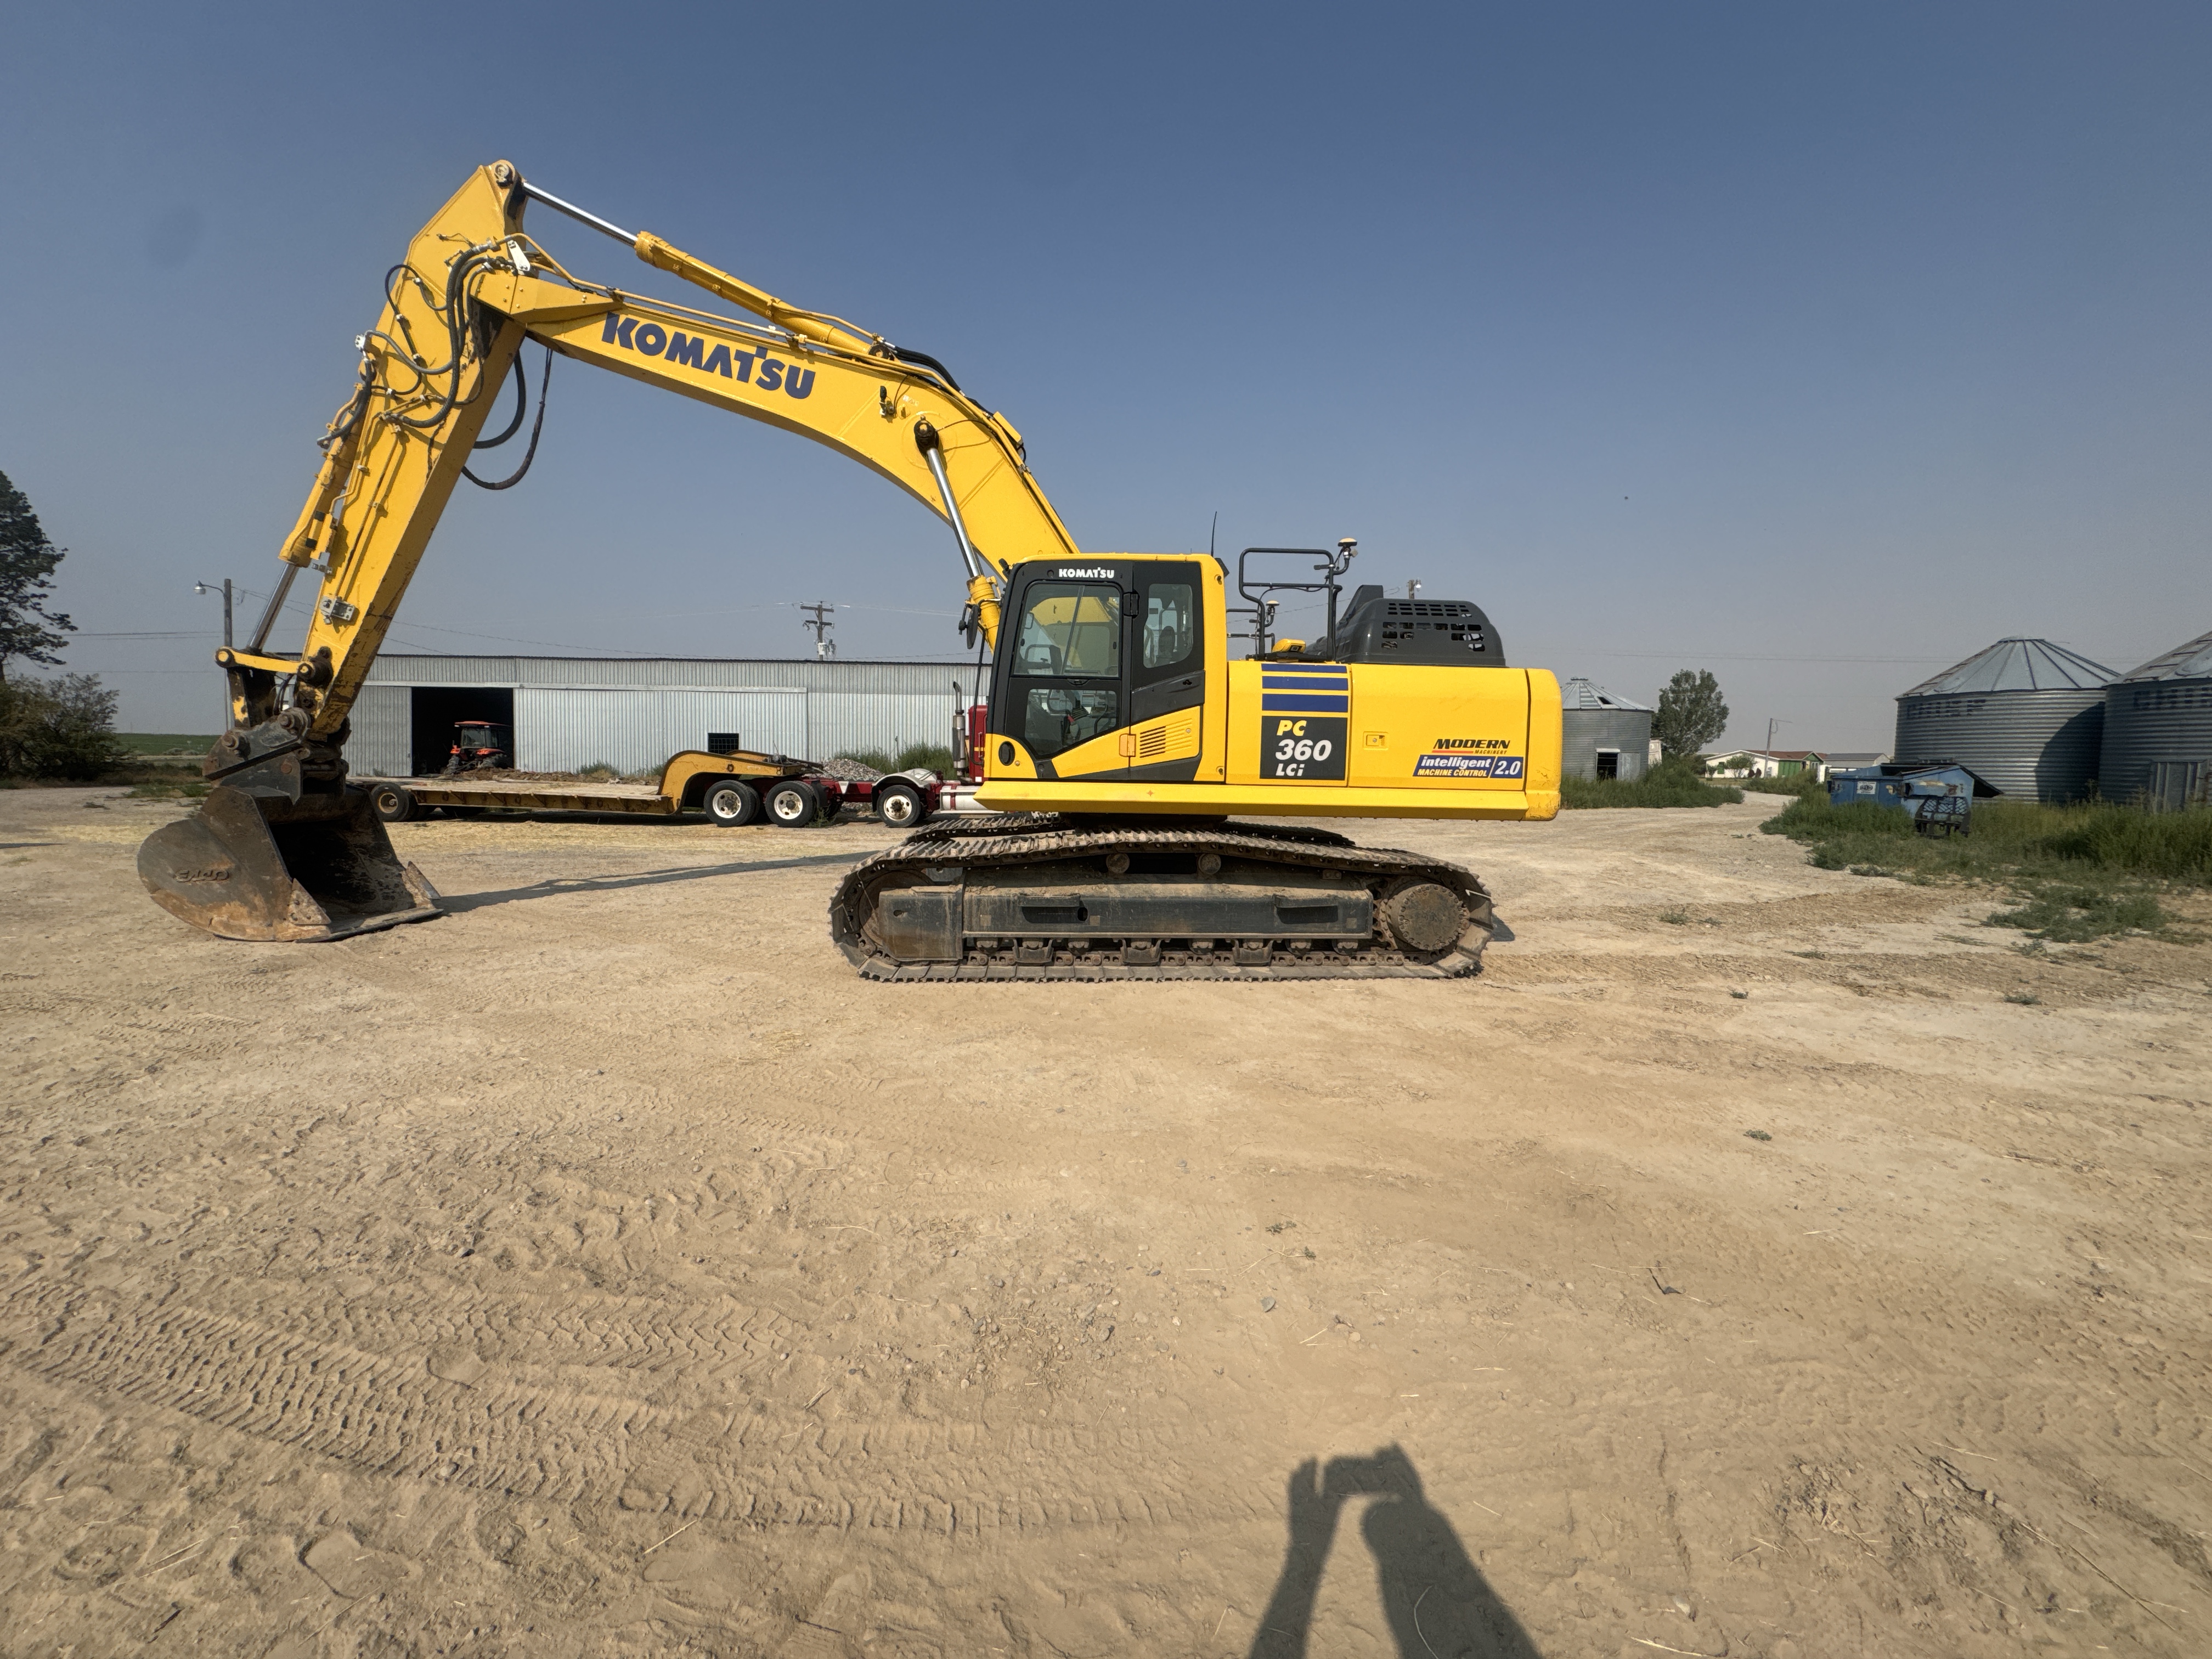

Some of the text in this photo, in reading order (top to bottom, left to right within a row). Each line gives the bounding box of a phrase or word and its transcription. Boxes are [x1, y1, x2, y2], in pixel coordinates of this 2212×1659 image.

[602, 311, 816, 399] KOMATSU
[1059, 567, 1114, 579] KOMATSU
[1276, 719, 1307, 737] PC
[1275, 738, 1332, 761] 360
[1433, 738, 1510, 749] MODERN
[1276, 763, 1305, 777] LCi
[1421, 756, 1521, 775] intelligent 2.0
